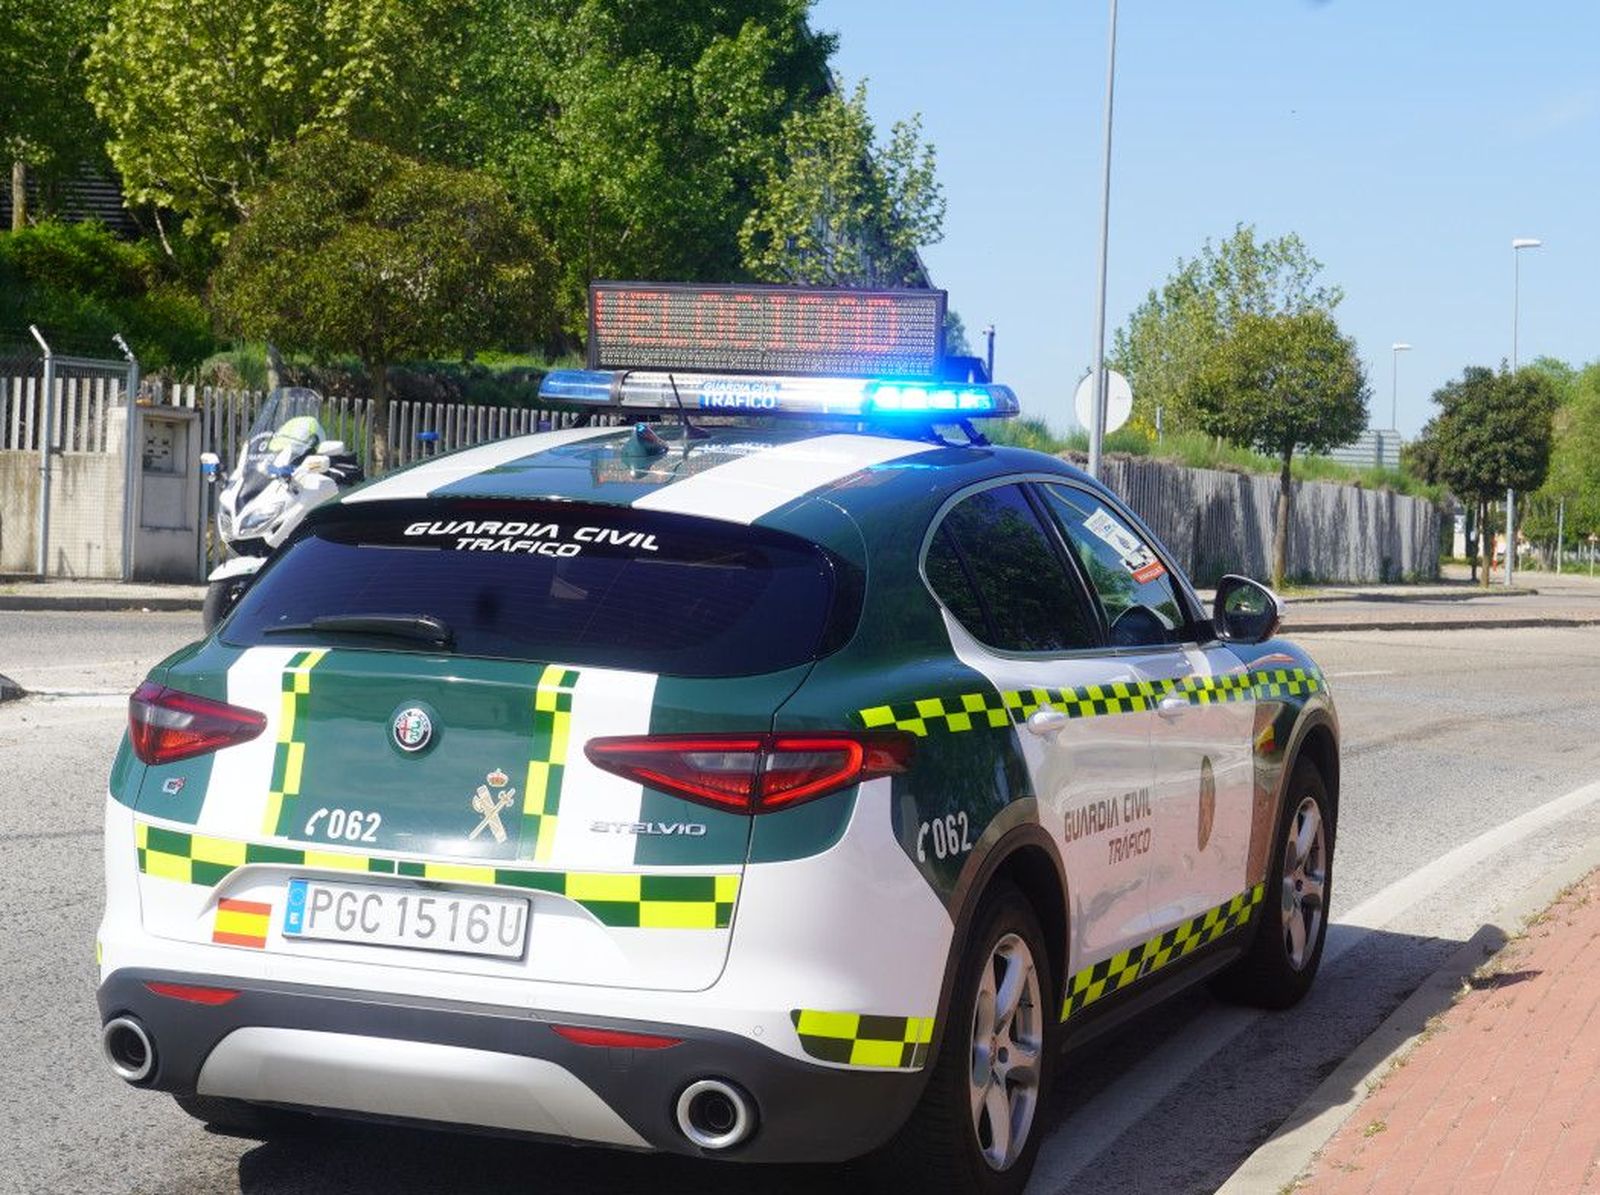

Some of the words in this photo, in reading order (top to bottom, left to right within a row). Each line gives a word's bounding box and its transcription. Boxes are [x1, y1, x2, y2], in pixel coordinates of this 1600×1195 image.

[594, 290, 902, 353] VELOCIDAD
[404, 521, 559, 538] GUARDIA
[573, 527, 659, 551] CIVIL
[455, 536, 582, 558] TRÁFICO
[327, 808, 382, 842] 062
[589, 821, 707, 836] STELVIO
[1064, 797, 1120, 843] GUARDIA
[1123, 786, 1152, 823] CIVIL
[933, 811, 973, 860] 062
